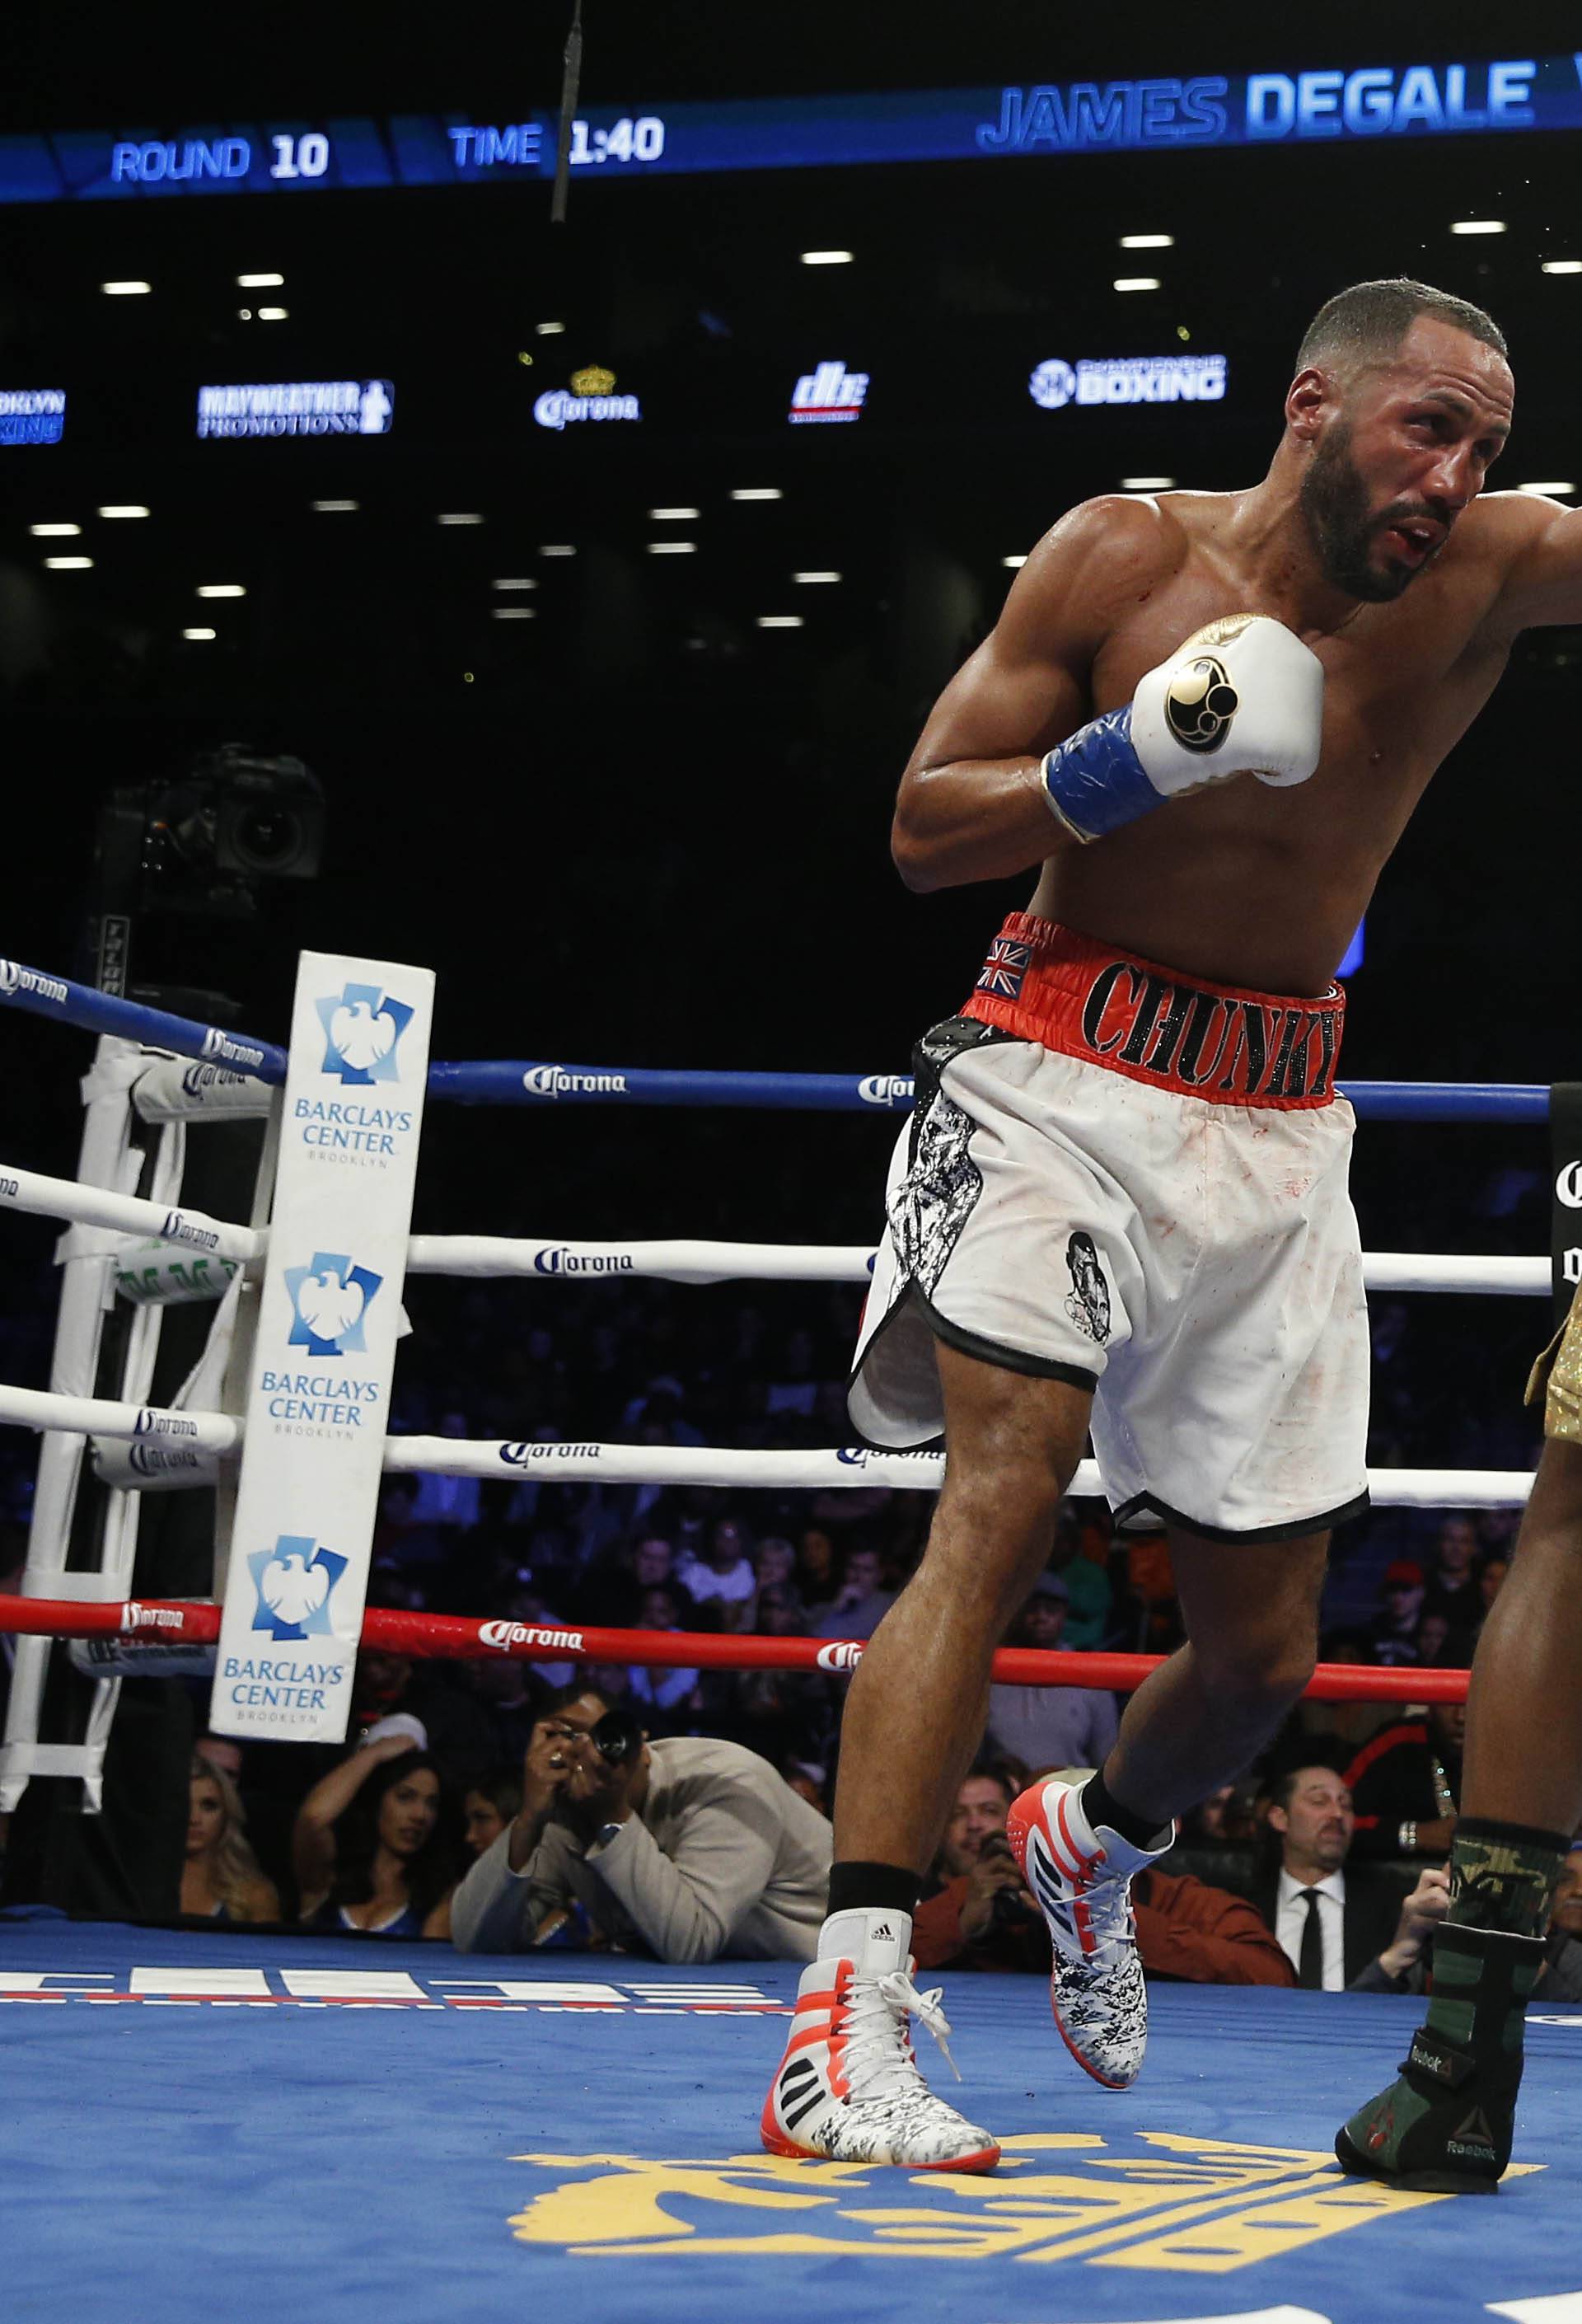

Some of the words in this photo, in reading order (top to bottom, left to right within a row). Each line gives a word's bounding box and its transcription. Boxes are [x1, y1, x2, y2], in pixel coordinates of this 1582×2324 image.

[976, 77, 1229, 152] JAMES
[1246, 60, 1538, 138] DEGALE
[447, 123, 544, 166] TIME
[568, 117, 664, 165] 1:40
[110, 138, 250, 182] ROUND
[270, 134, 329, 179] 10
[1075, 370, 1225, 405] BOXING
[534, 389, 639, 430] Corona
[201, 1027, 264, 1067] Corona
[523, 1065, 630, 1099] Corona
[295, 1098, 412, 1132] BARCLAYS
[303, 1125, 396, 1155] CENTER
[308, 1150, 387, 1169] BROOKLYN
[160, 1211, 219, 1248] Corona
[534, 1247, 634, 1276] Corona
[261, 1371, 379, 1401] BARCLAYS
[134, 1409, 198, 1436] Corona
[269, 1399, 361, 1426] CENTER
[274, 1424, 354, 1440] BROOKLYN
[499, 1443, 601, 1469] Corona
[120, 1602, 184, 1633] Corona
[479, 1620, 586, 1652] Corona
[224, 1658, 343, 1684] BARCLAYS
[232, 1684, 325, 1709] CENTER
[237, 1711, 319, 1724] BROOKLYN
[1447, 2141, 1495, 2161] Reebok
